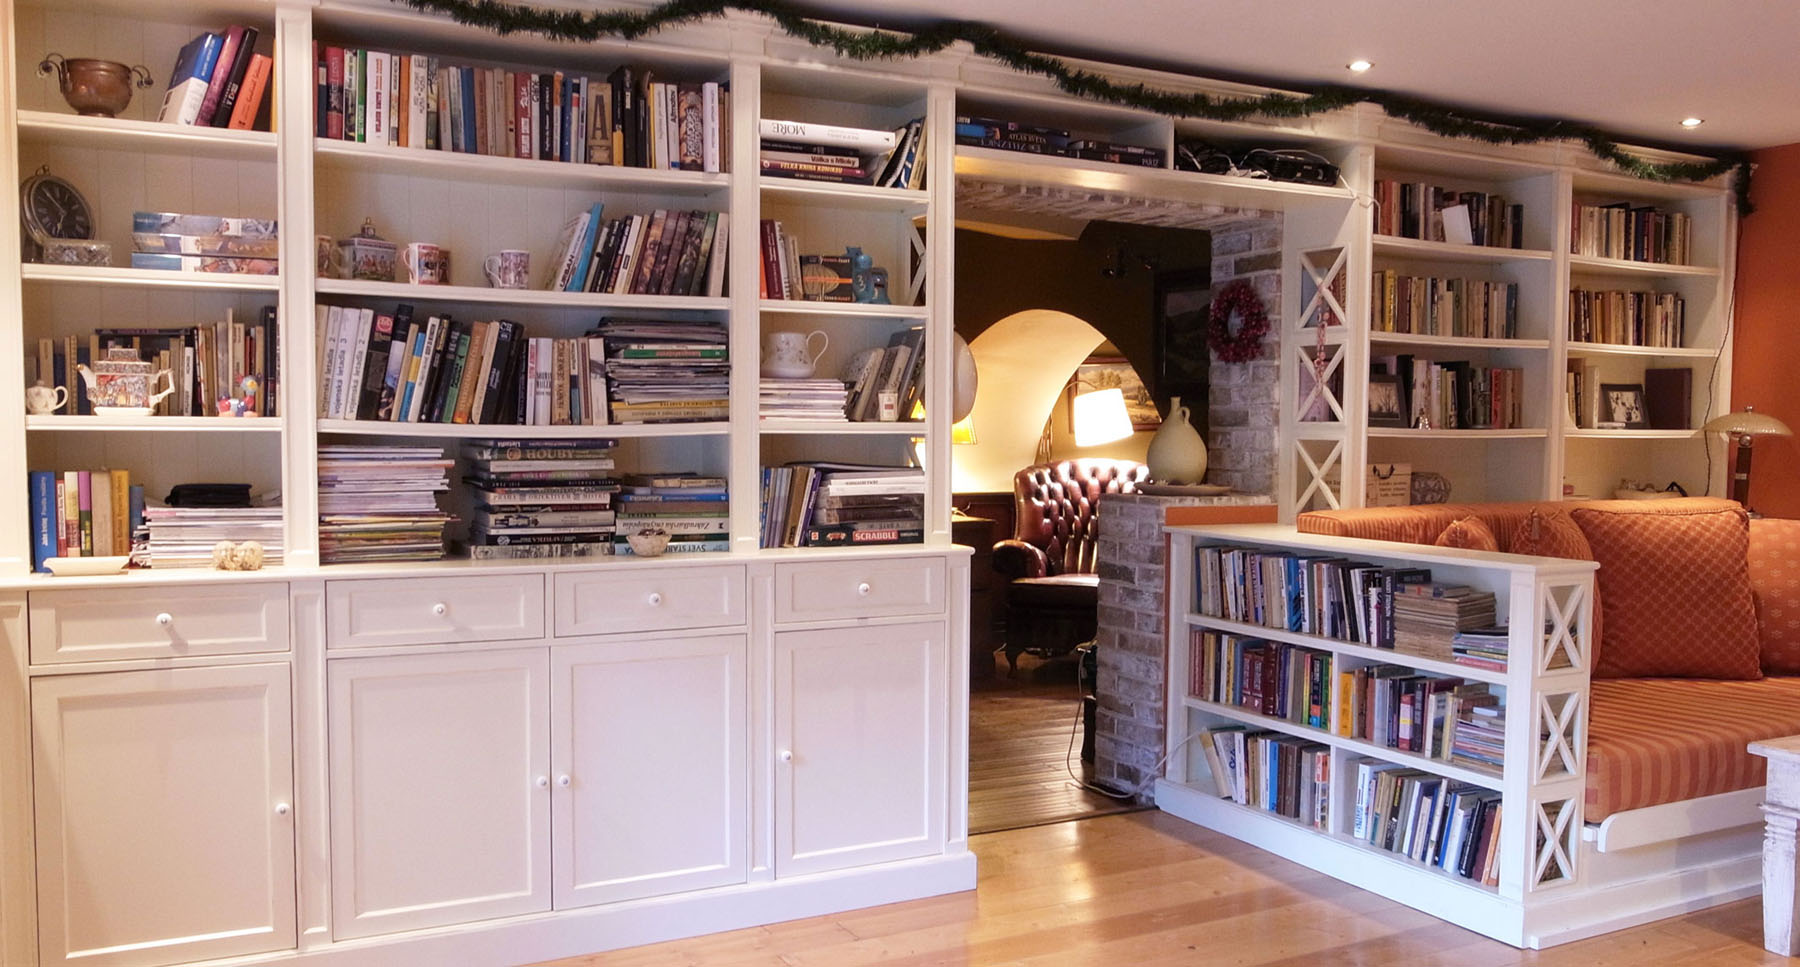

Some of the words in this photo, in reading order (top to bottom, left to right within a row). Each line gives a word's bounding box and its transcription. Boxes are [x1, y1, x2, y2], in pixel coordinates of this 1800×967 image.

[591, 93, 608, 141] A
[336, 350, 346, 376] letadla
[353, 350, 363, 376] letadla
[526, 449, 574, 459] HOUBY
[855, 531, 897, 541] SCRABBLE
